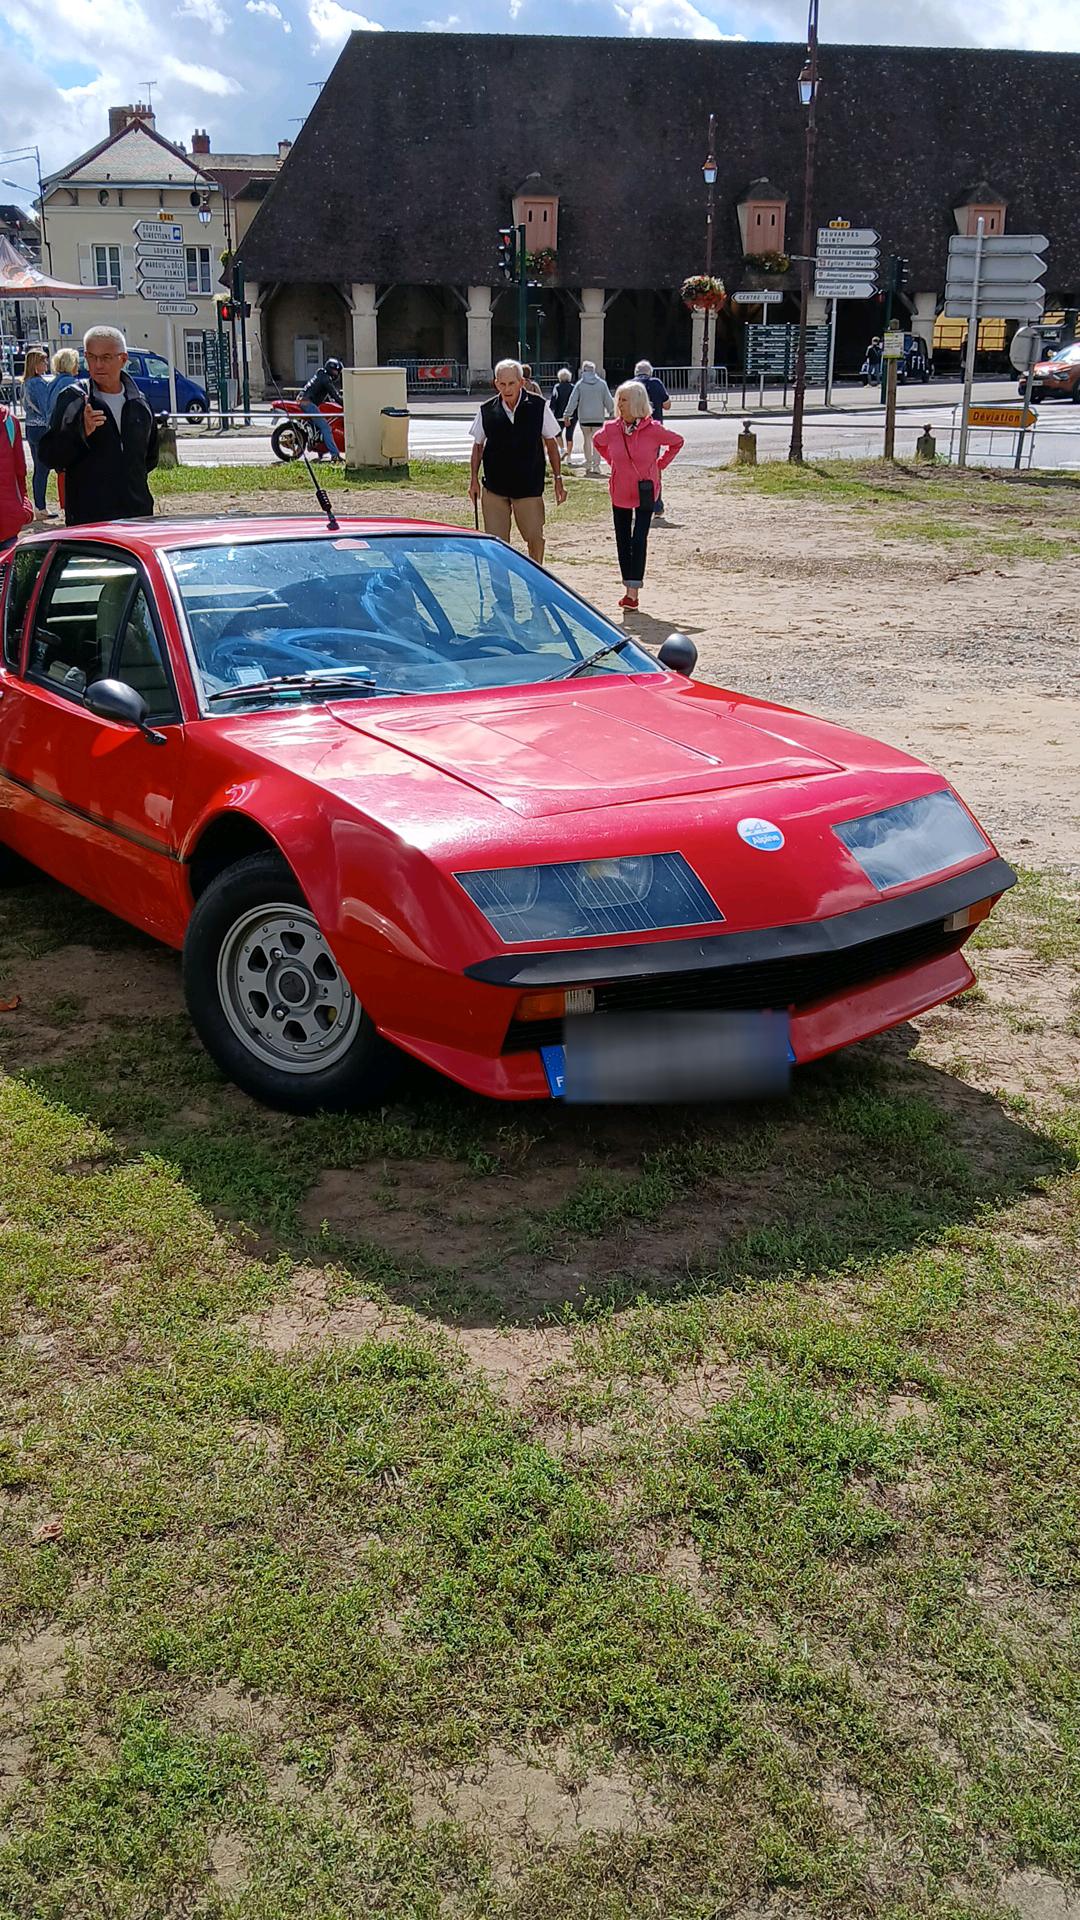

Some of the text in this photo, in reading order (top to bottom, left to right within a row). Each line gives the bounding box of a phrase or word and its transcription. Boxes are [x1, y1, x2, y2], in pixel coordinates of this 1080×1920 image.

[142, 224, 162, 232] TOUTES
[142, 232, 171, 240] DIRECTIONS
[145, 261, 166, 269] MAREUIL
[973, 411, 1021, 422] Déviation
[751, 834, 781, 845] Alpine
[555, 1075, 565, 1088] F
